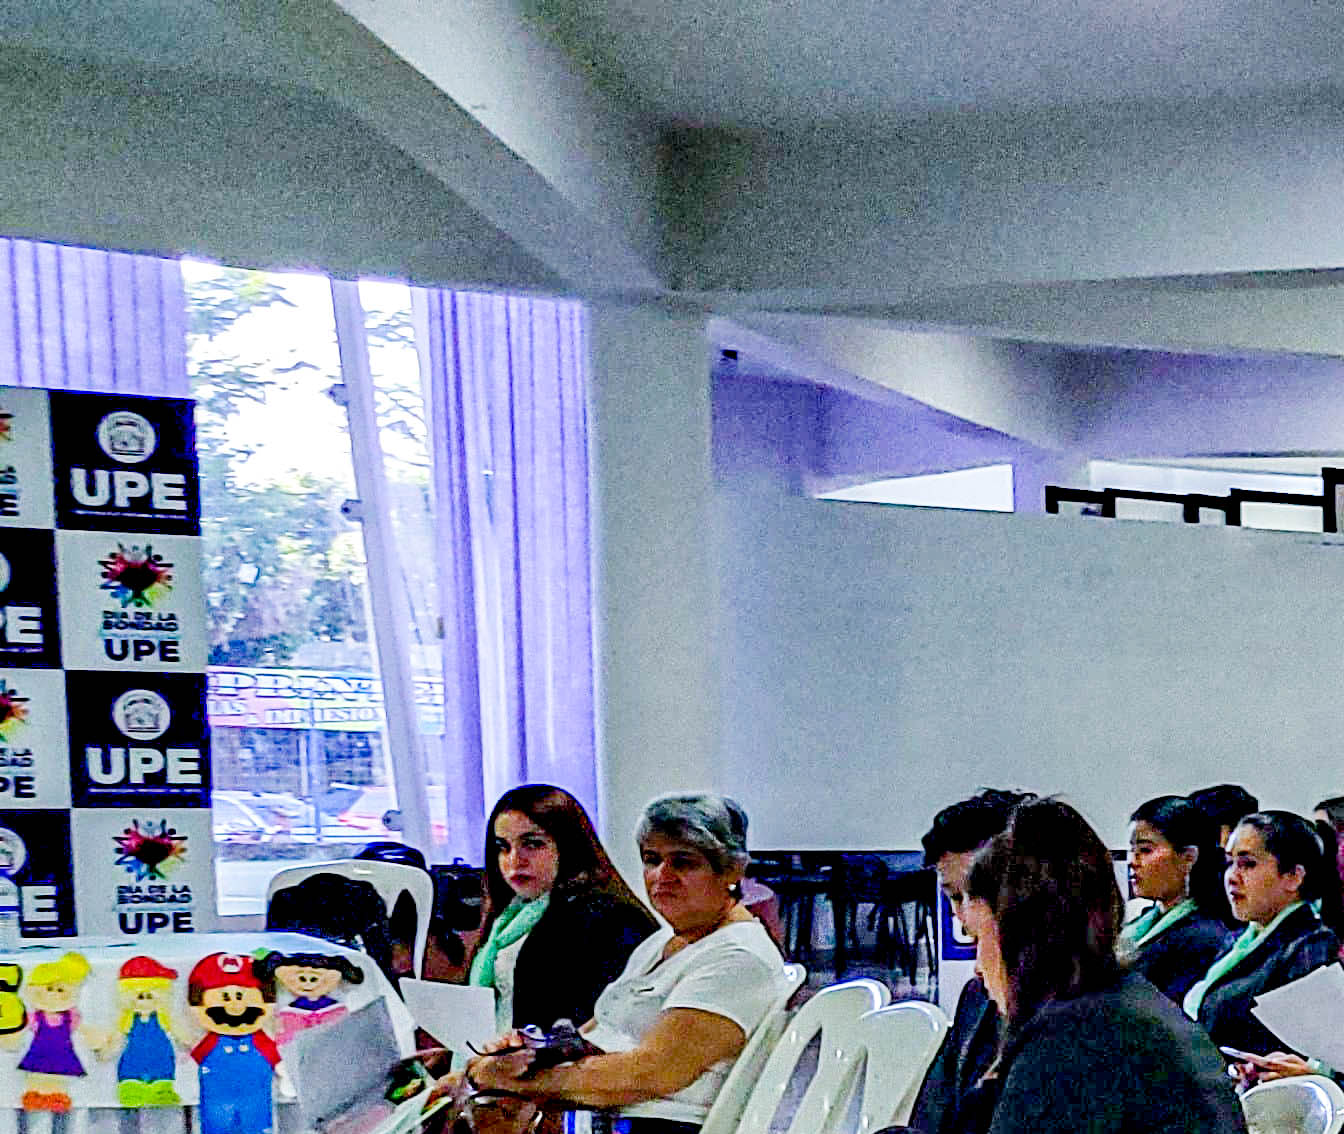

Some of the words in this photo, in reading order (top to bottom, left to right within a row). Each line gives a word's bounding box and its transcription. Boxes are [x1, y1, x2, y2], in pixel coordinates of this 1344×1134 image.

[70, 467, 188, 511] UPE
[104, 639, 180, 663] UPE
[86, 747, 203, 785] UPE
[119, 911, 194, 935] UPE
